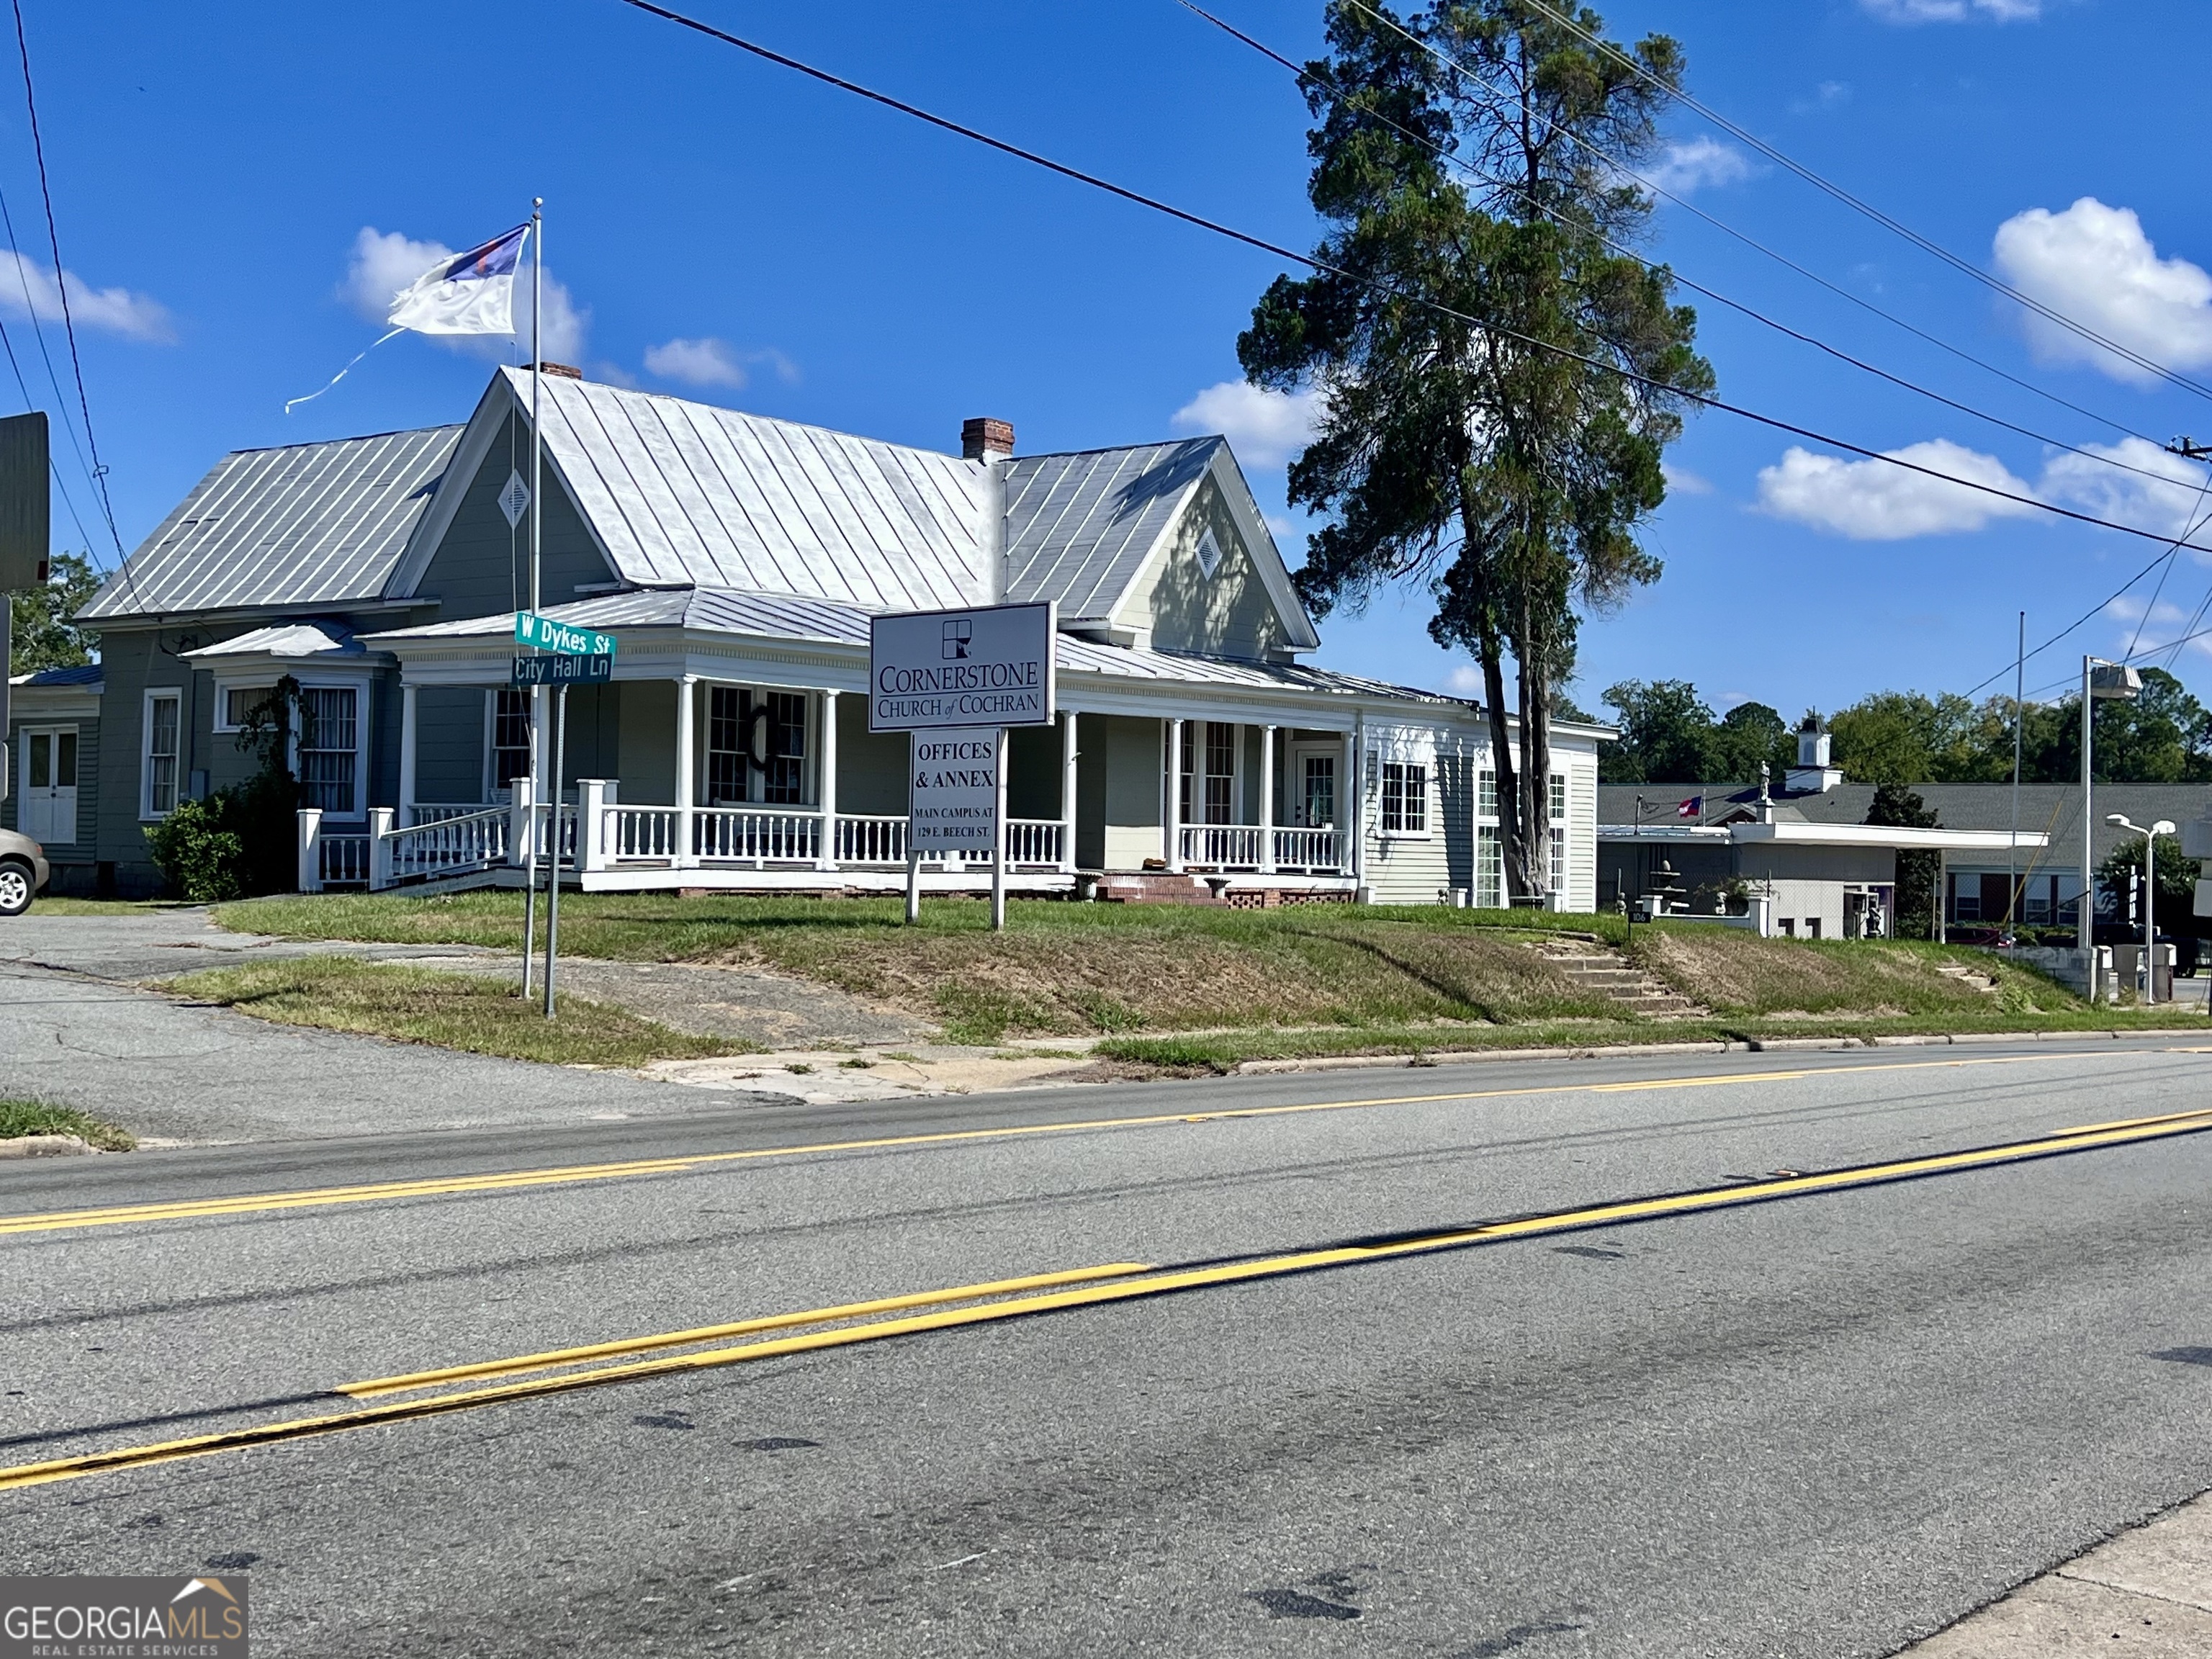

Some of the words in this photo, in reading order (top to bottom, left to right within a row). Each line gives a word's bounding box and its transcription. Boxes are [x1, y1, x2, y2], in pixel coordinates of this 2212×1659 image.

[522, 614, 535, 638] W
[541, 621, 587, 652] Dykes
[593, 635, 611, 654] St
[516, 657, 545, 683] City
[553, 655, 582, 678] Hall
[590, 655, 608, 675] Ln
[879, 662, 1038, 693] CORNERSTONE
[878, 698, 942, 719] CHURCH
[945, 698, 958, 719] of
[959, 693, 1038, 714] COCHRAN
[918, 742, 992, 760] OFFICES
[916, 771, 928, 788] &
[932, 770, 994, 788] ANNEX
[914, 808, 938, 818] MAIN
[941, 808, 980, 818] CAMPUS
[981, 807, 994, 817] AT
[918, 827, 931, 837] 129
[932, 827, 940, 837] E.
[943, 827, 975, 837] BEECH
[976, 827, 990, 837] ST.
[1633, 912, 1646, 922] 106
